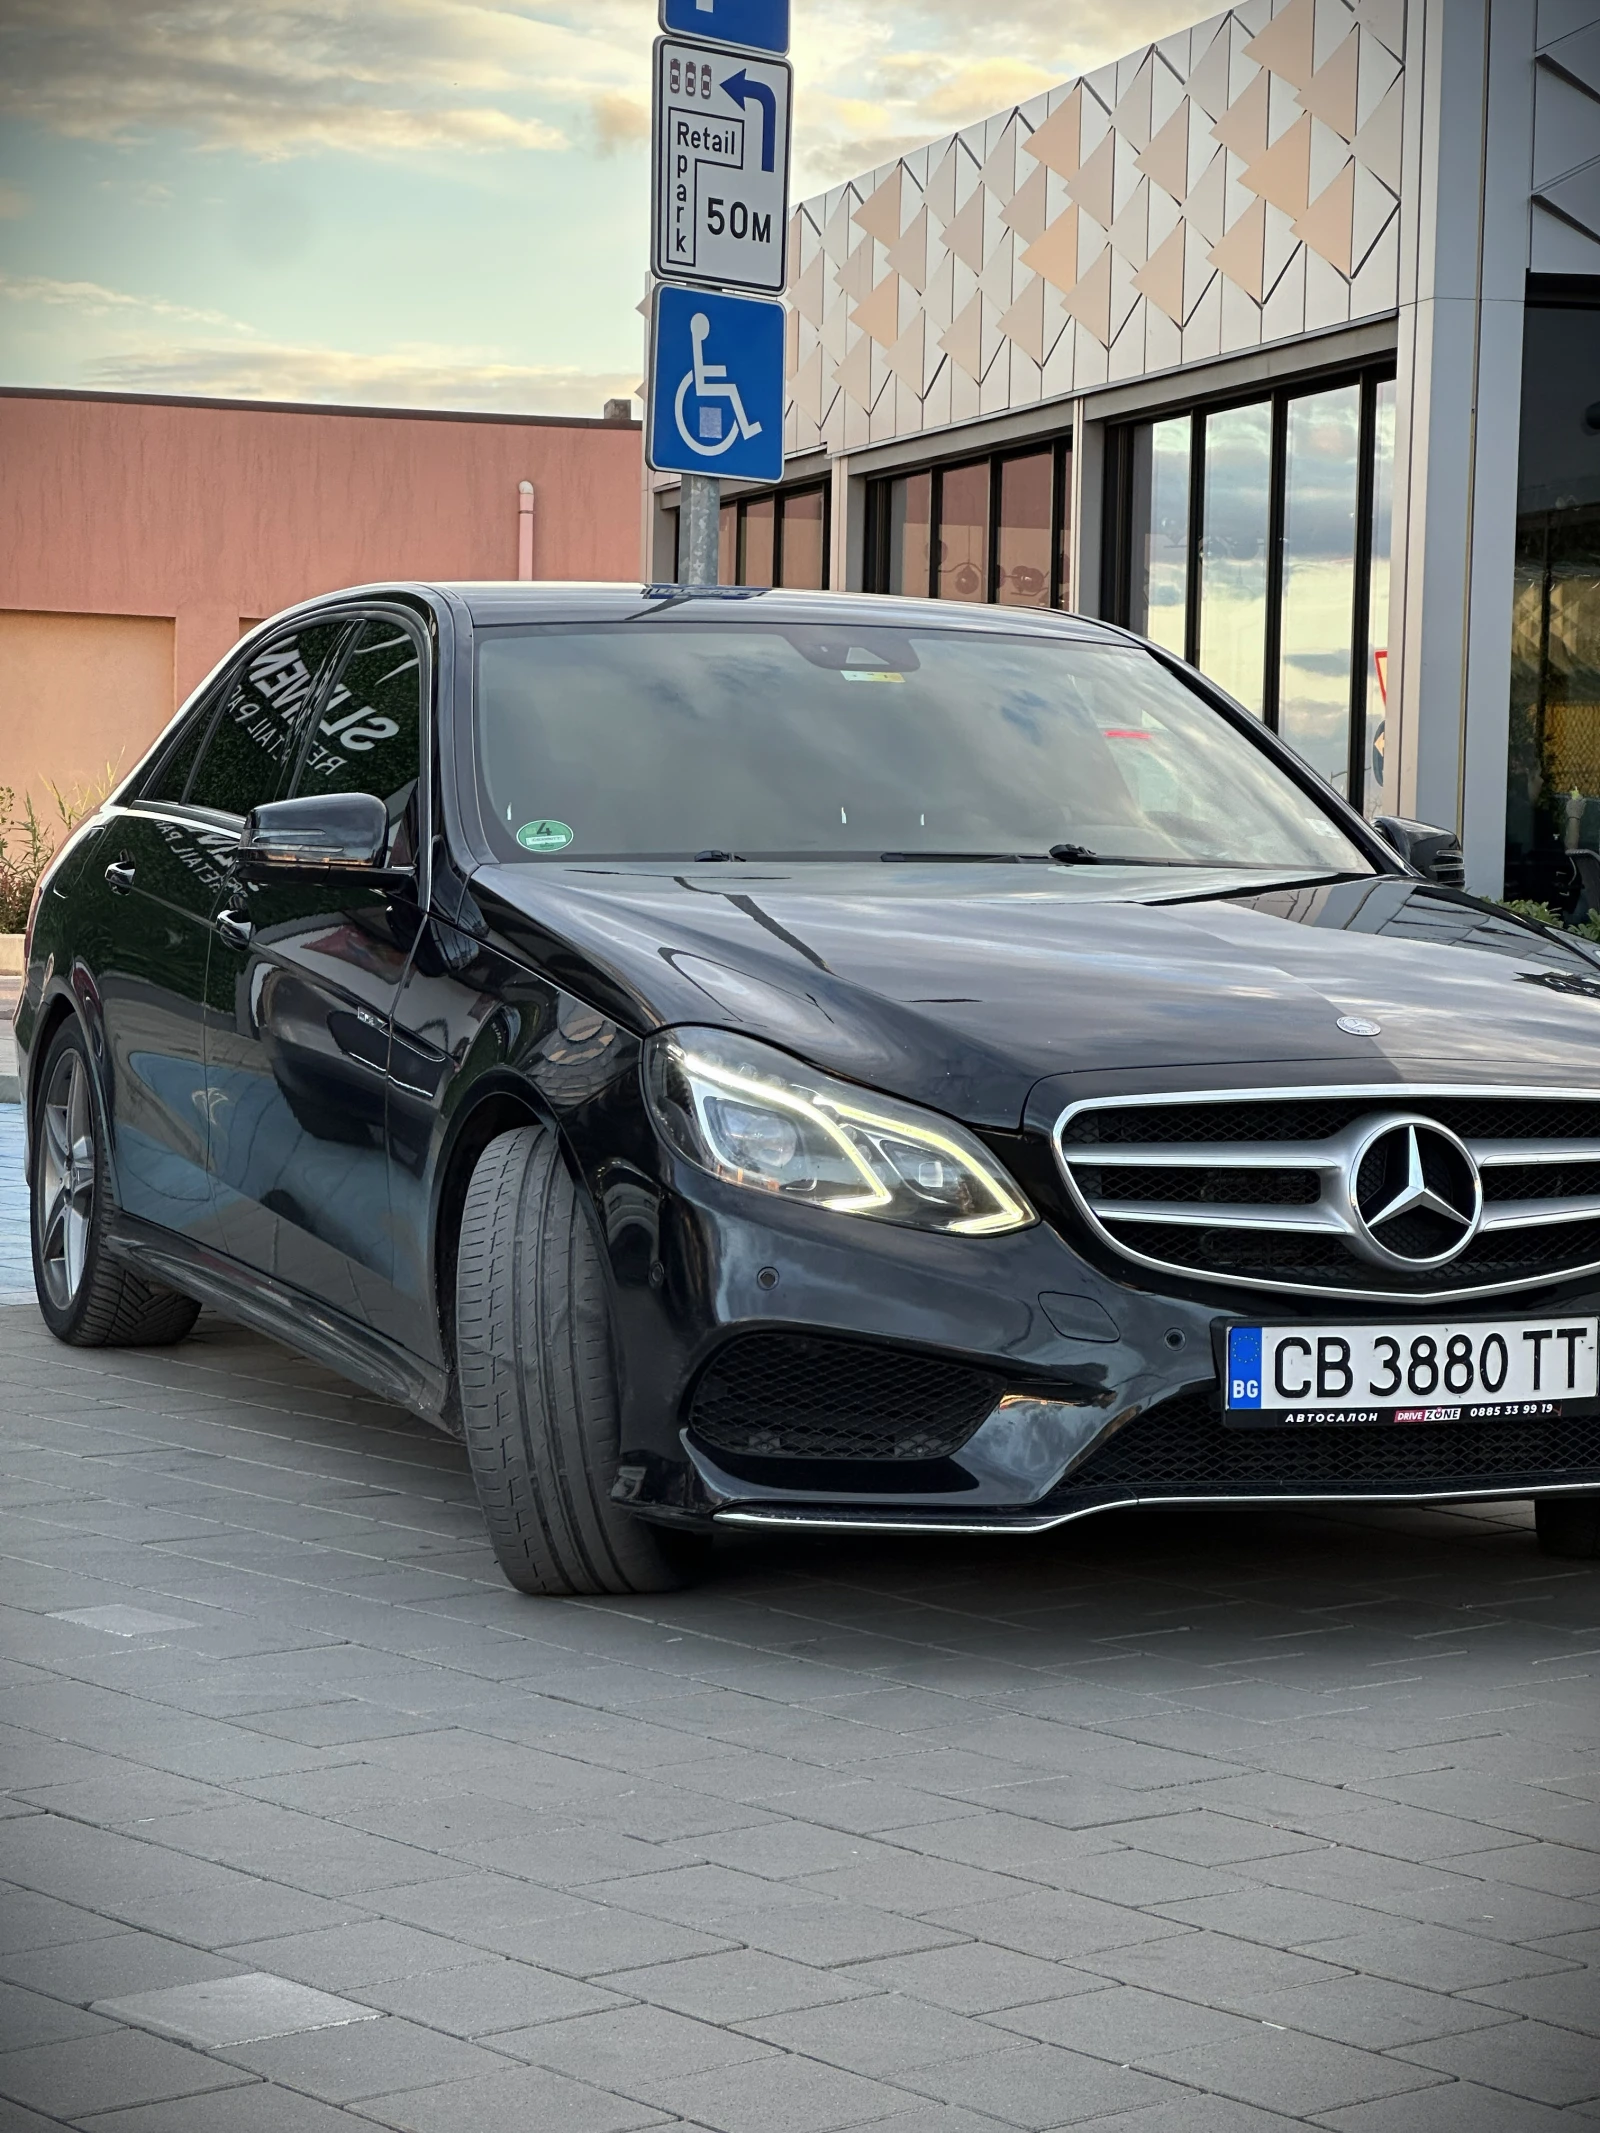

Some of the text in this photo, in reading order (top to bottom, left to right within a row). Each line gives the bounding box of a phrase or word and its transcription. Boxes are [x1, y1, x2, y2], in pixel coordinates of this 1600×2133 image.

[677, 121, 736, 155] Retail
[676, 154, 688, 253] park
[536, 822, 552, 836] 4
[1274, 1327, 1588, 1398] CB 3880 TT
[1233, 1380, 1259, 1399] BG
[1285, 1412, 1379, 1423] АВТОСАЛОН
[1470, 1406, 1501, 1417] 0885
[1504, 1405, 1519, 1415] 33
[1522, 1404, 1537, 1414] 99
